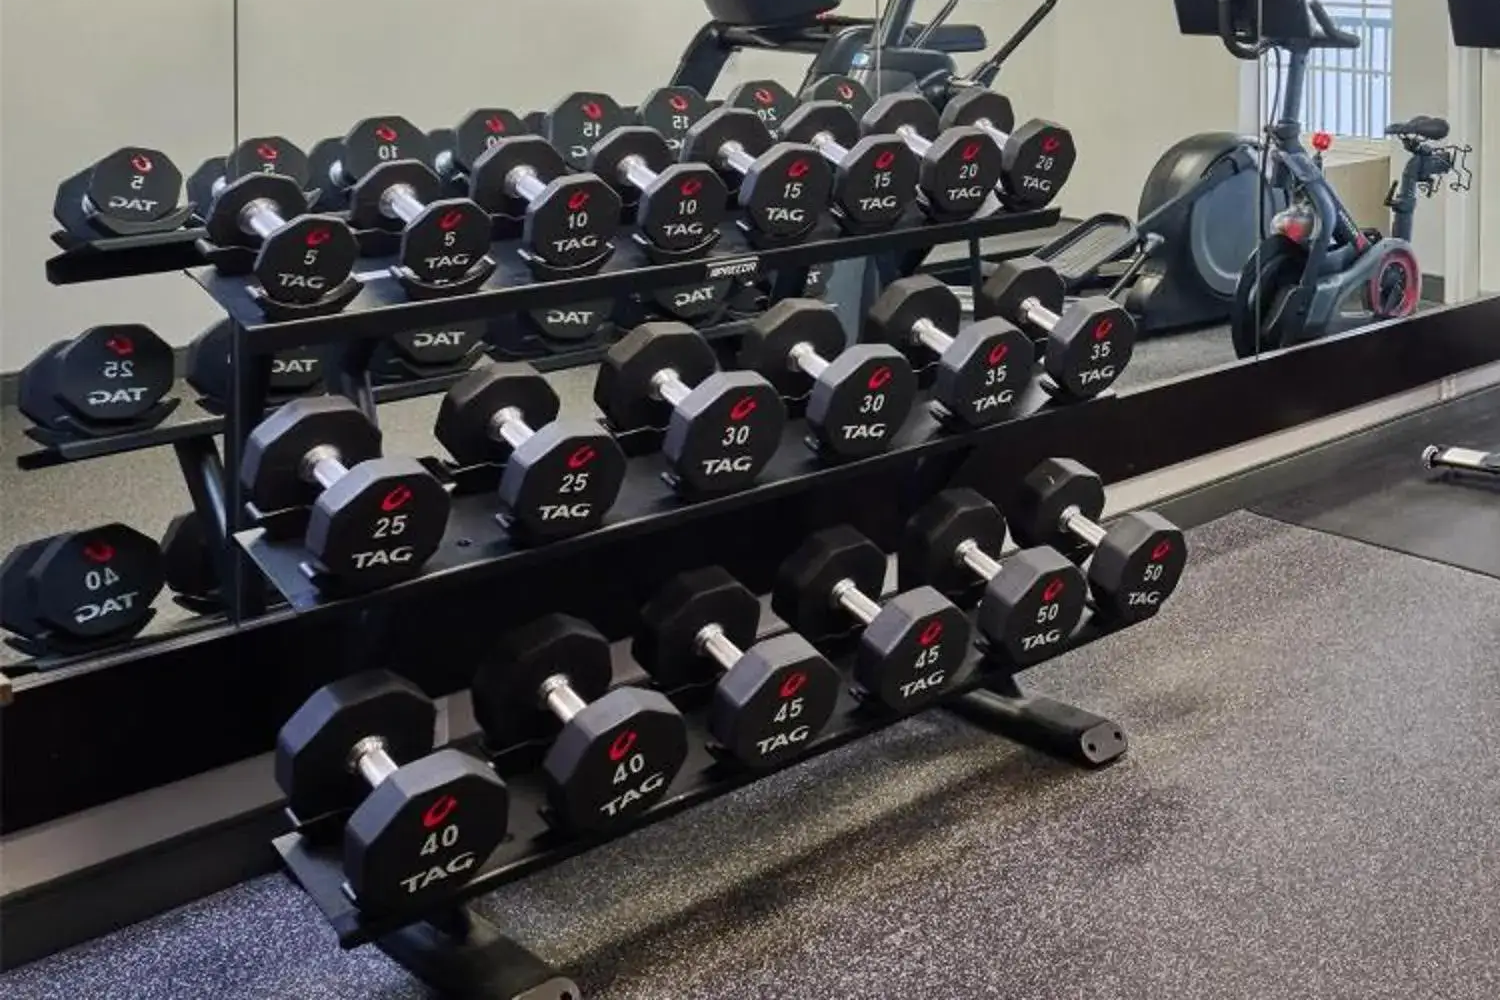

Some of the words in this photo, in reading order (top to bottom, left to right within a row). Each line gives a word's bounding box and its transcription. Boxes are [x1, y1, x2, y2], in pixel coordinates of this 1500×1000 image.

[874, 171, 892, 189] 15
[959, 163, 979, 179] 20
[783, 182, 803, 199] 15
[947, 185, 981, 201] TAG
[1023, 175, 1051, 192] TAG
[679, 199, 697, 215] 10
[859, 195, 897, 211] TAG
[568, 211, 588, 229] 10
[766, 207, 804, 223] TAG
[444, 231, 456, 247] 5
[663, 223, 703, 237] TAG
[552, 235, 598, 253] TAG
[303, 249, 318, 265] 5
[425, 253, 470, 270] TAG
[278, 273, 324, 289] TAG
[1090, 340, 1111, 361] 35
[985, 364, 1007, 386] 35
[1077, 365, 1116, 387] TAG
[859, 393, 885, 414] 30
[972, 389, 1013, 412] TAG
[722, 425, 750, 446] 30
[842, 423, 886, 440] TAG
[702, 455, 752, 475] TAG
[559, 472, 589, 493] 25
[539, 503, 591, 521] TAG
[373, 514, 408, 539] 25
[351, 546, 413, 569] TAG
[1143, 564, 1163, 582] 50
[1127, 590, 1161, 606] TAG
[1036, 603, 1059, 624] 50
[1021, 629, 1060, 651] TAG
[914, 644, 941, 671] 45
[899, 669, 945, 699] TAG
[773, 697, 804, 723] 45
[756, 725, 809, 755] TAG
[612, 753, 646, 785] 40
[599, 772, 665, 817] TAG
[419, 824, 460, 857] 40
[400, 851, 476, 894] TAG
